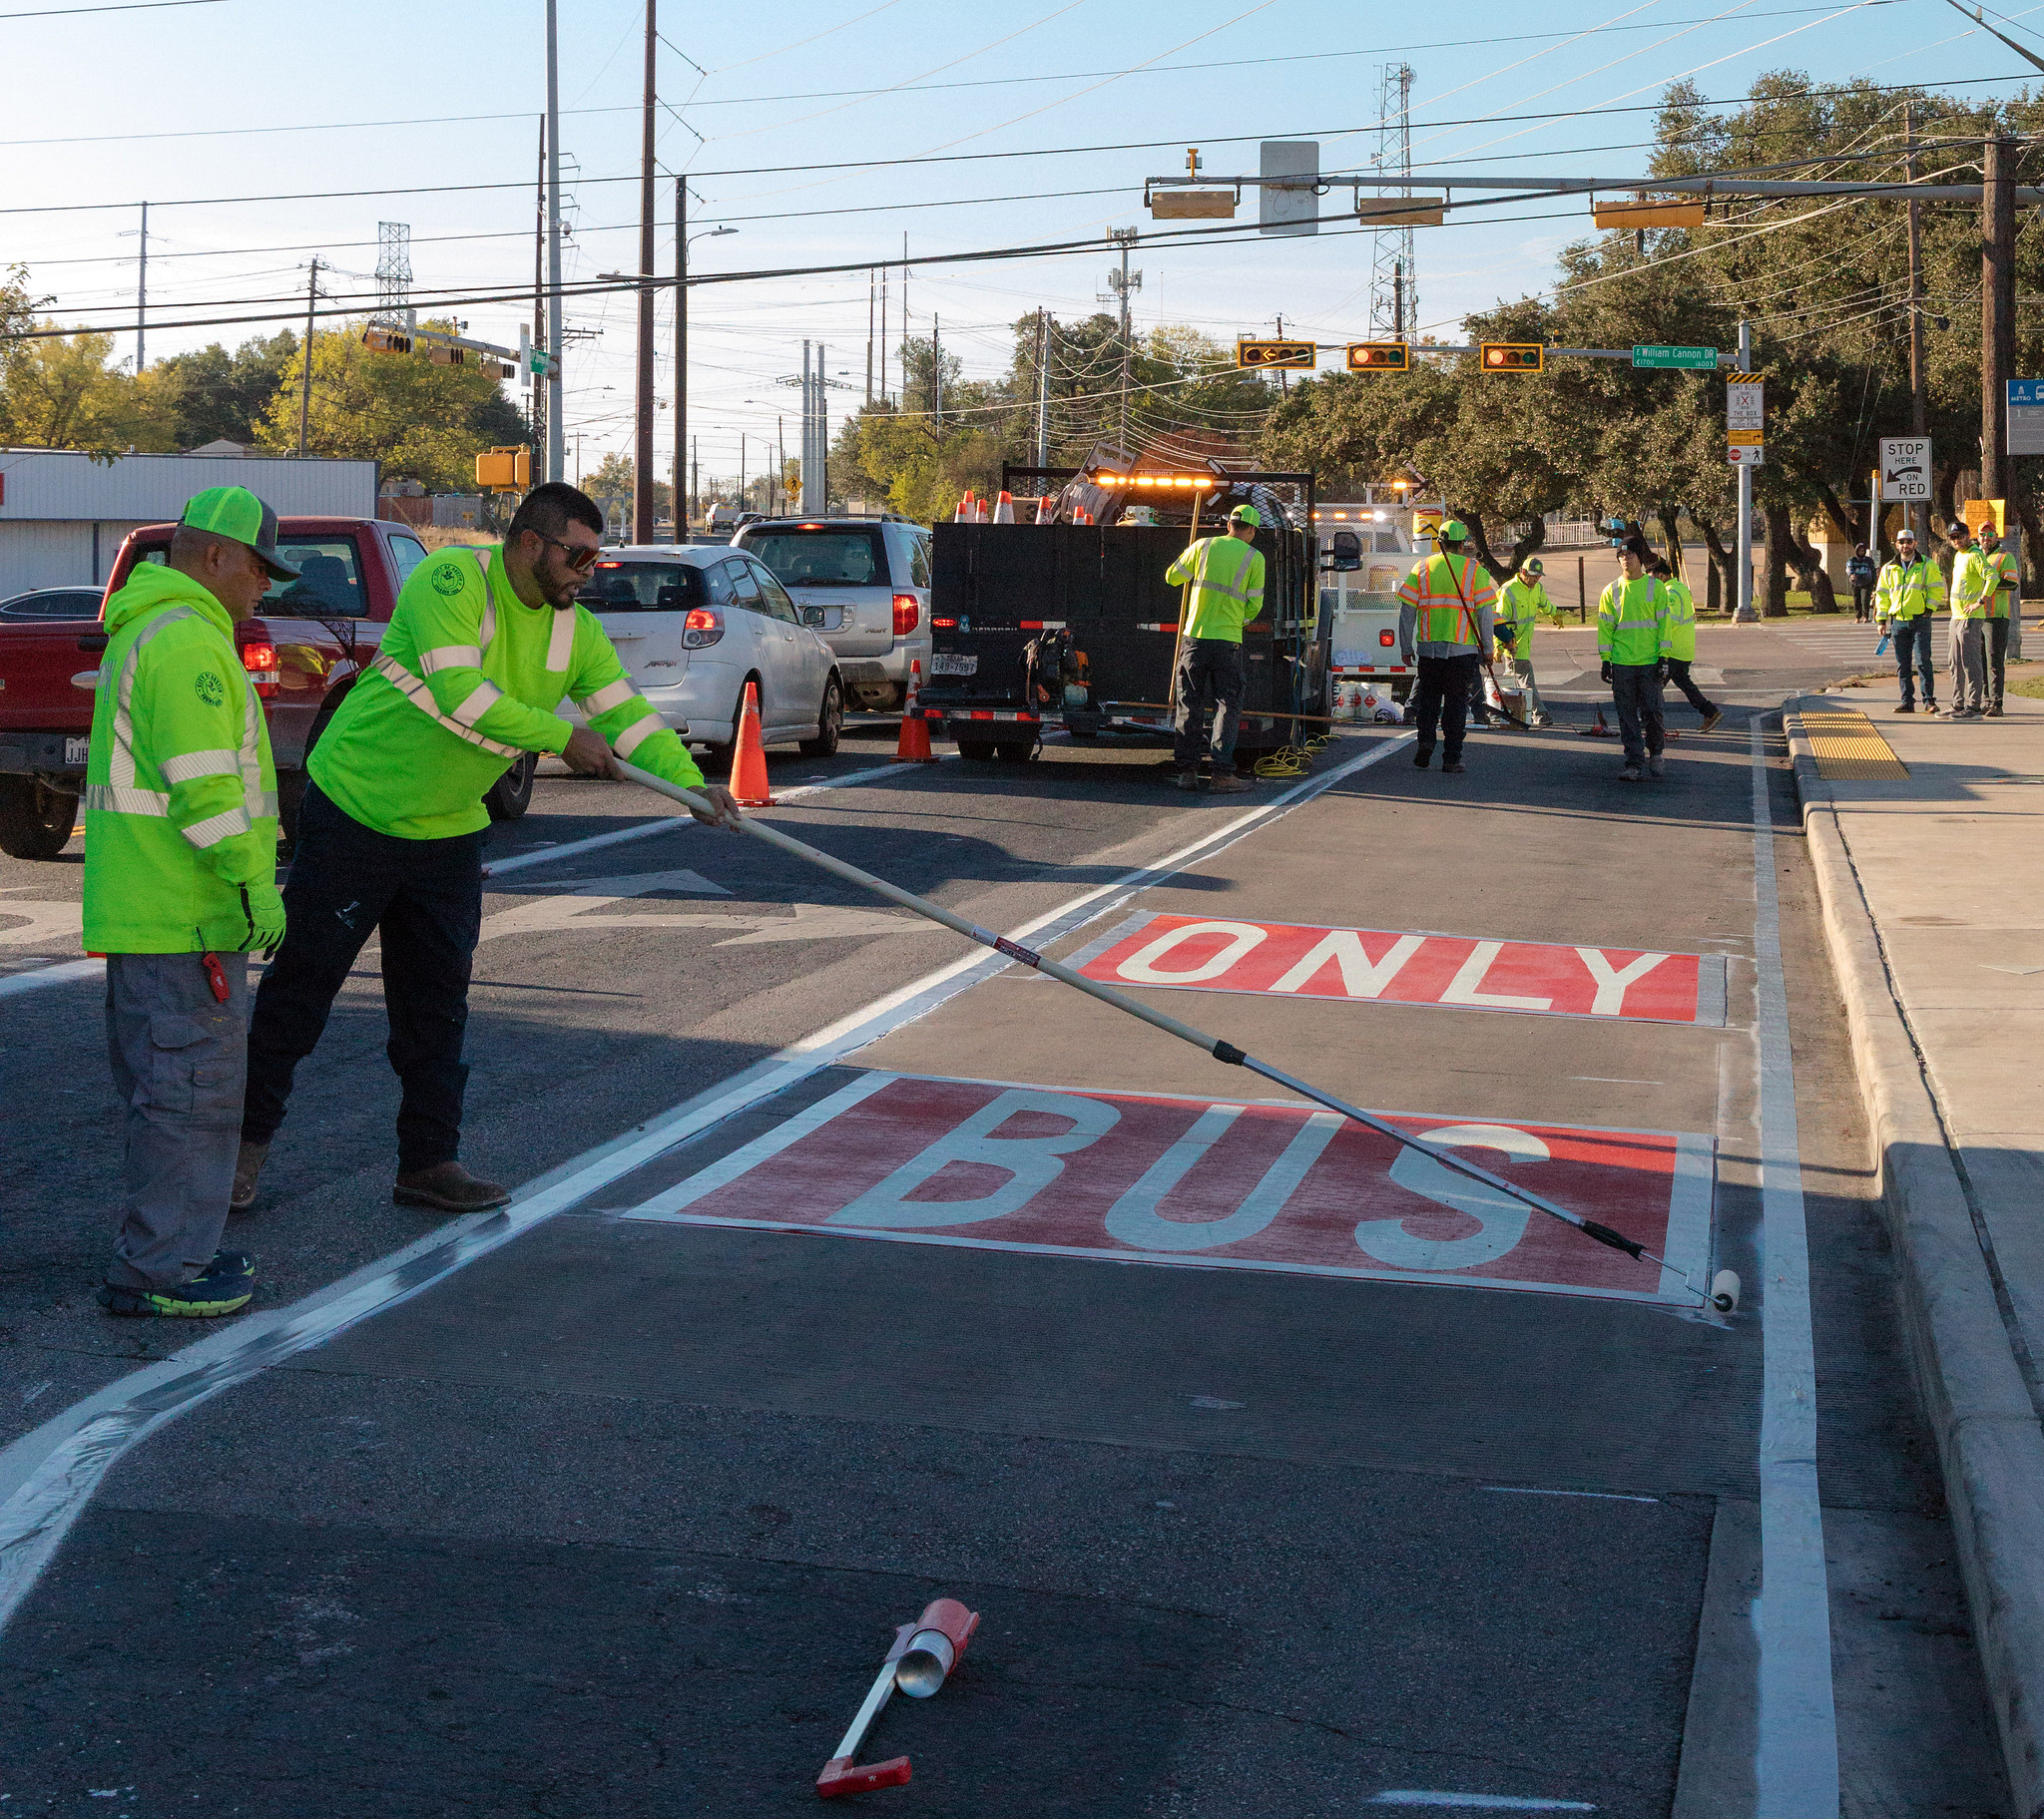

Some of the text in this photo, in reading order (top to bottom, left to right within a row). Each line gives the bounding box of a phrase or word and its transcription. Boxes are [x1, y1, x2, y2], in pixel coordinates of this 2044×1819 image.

[1642, 347, 1670, 358] William
[1672, 347, 1702, 359] Cannon
[1704, 348, 1715, 359] DR
[1888, 443, 1924, 455] STOP
[1894, 456, 1917, 465] HERE
[1906, 473, 1918, 482] ON
[1899, 483, 1926, 496] RED
[1116, 921, 1671, 1016] ONLY
[823, 1088, 1551, 1270] BUS
